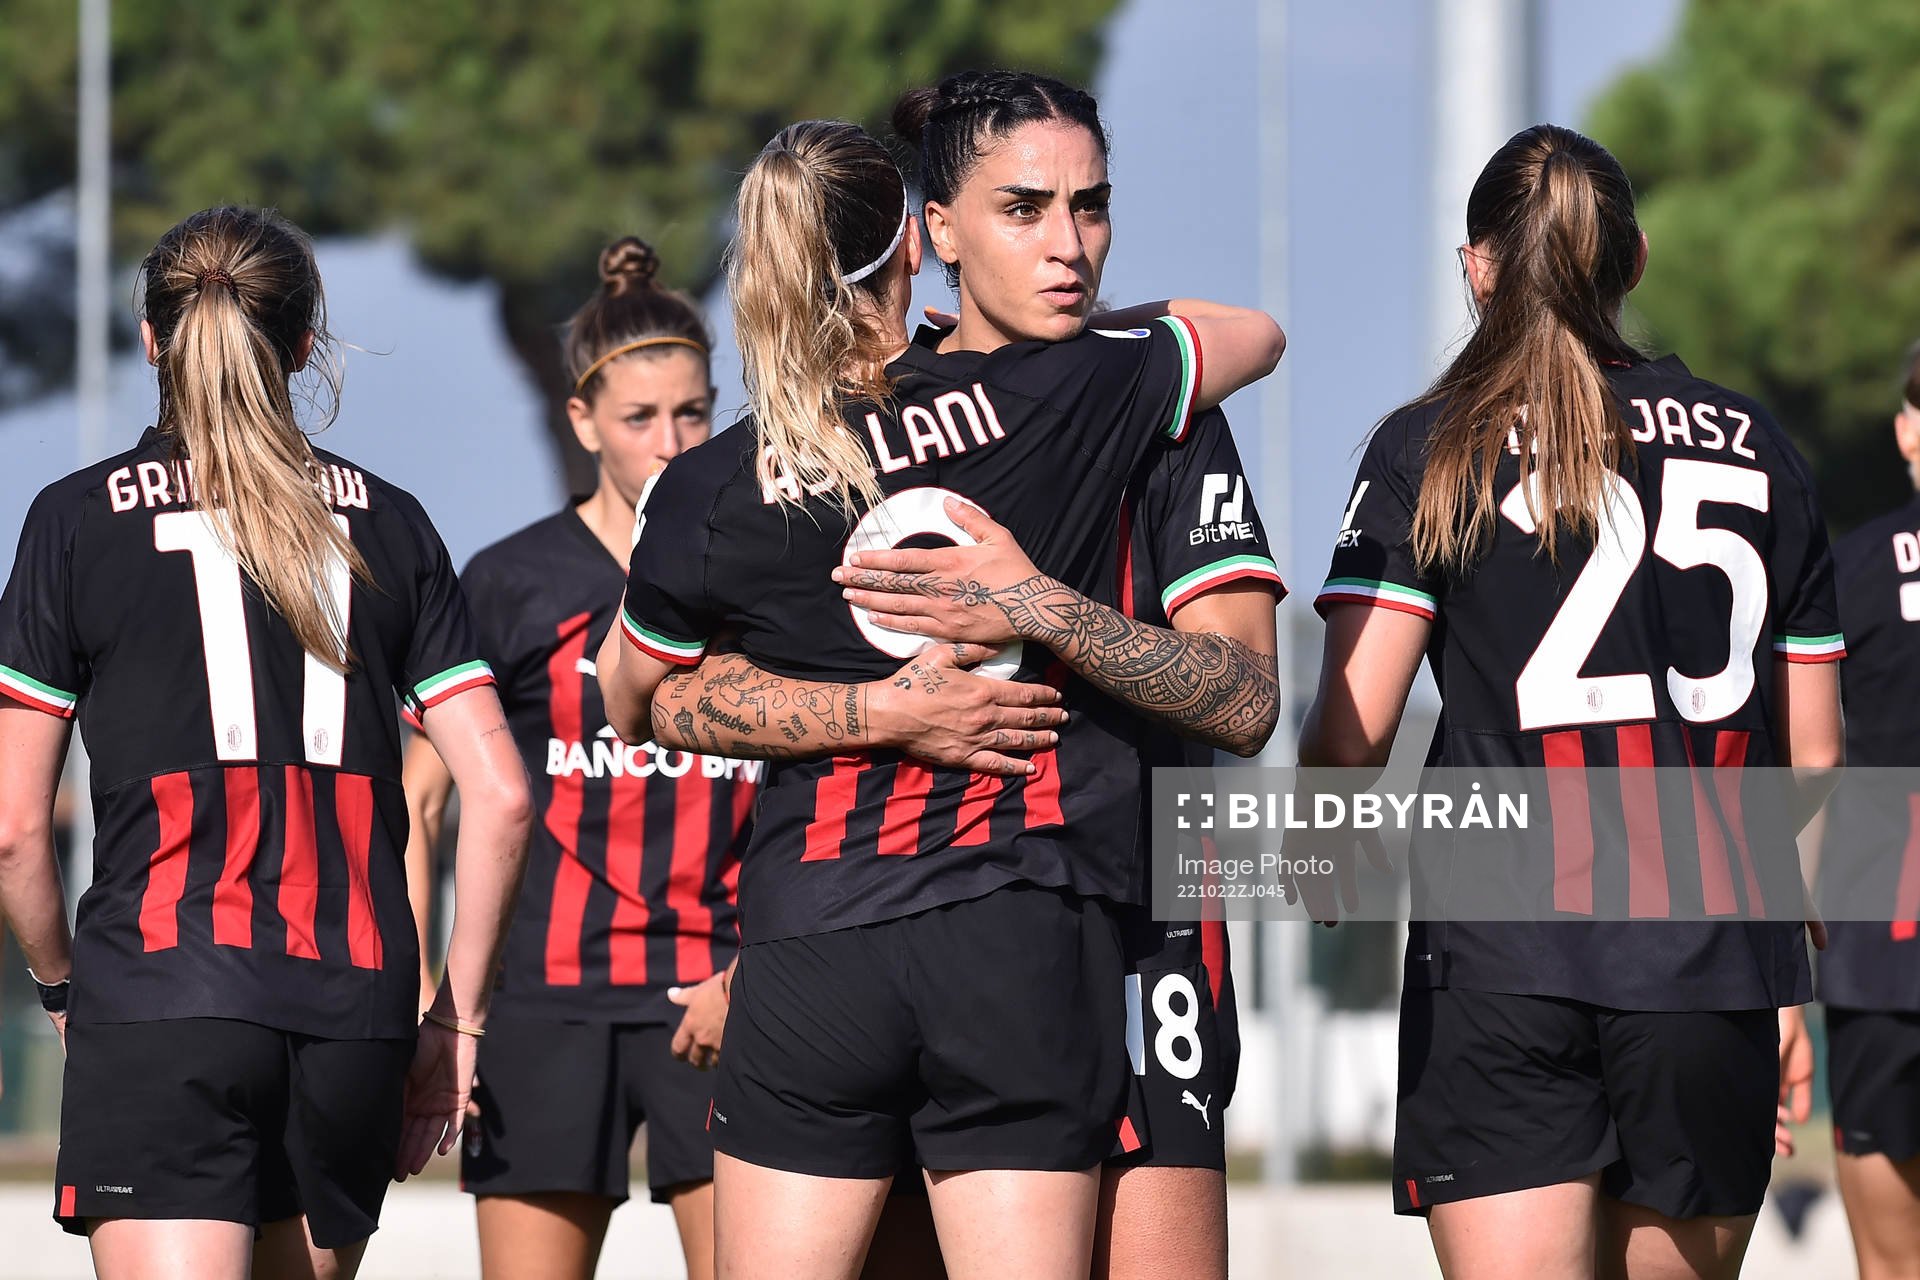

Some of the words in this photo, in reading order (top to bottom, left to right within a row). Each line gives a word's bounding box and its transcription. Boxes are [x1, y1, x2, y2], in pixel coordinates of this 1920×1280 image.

[758, 383, 1006, 505] ASLANI
[152, 507, 351, 767] 11
[1500, 457, 1770, 732] 25
[546, 738, 694, 779] BANCO
